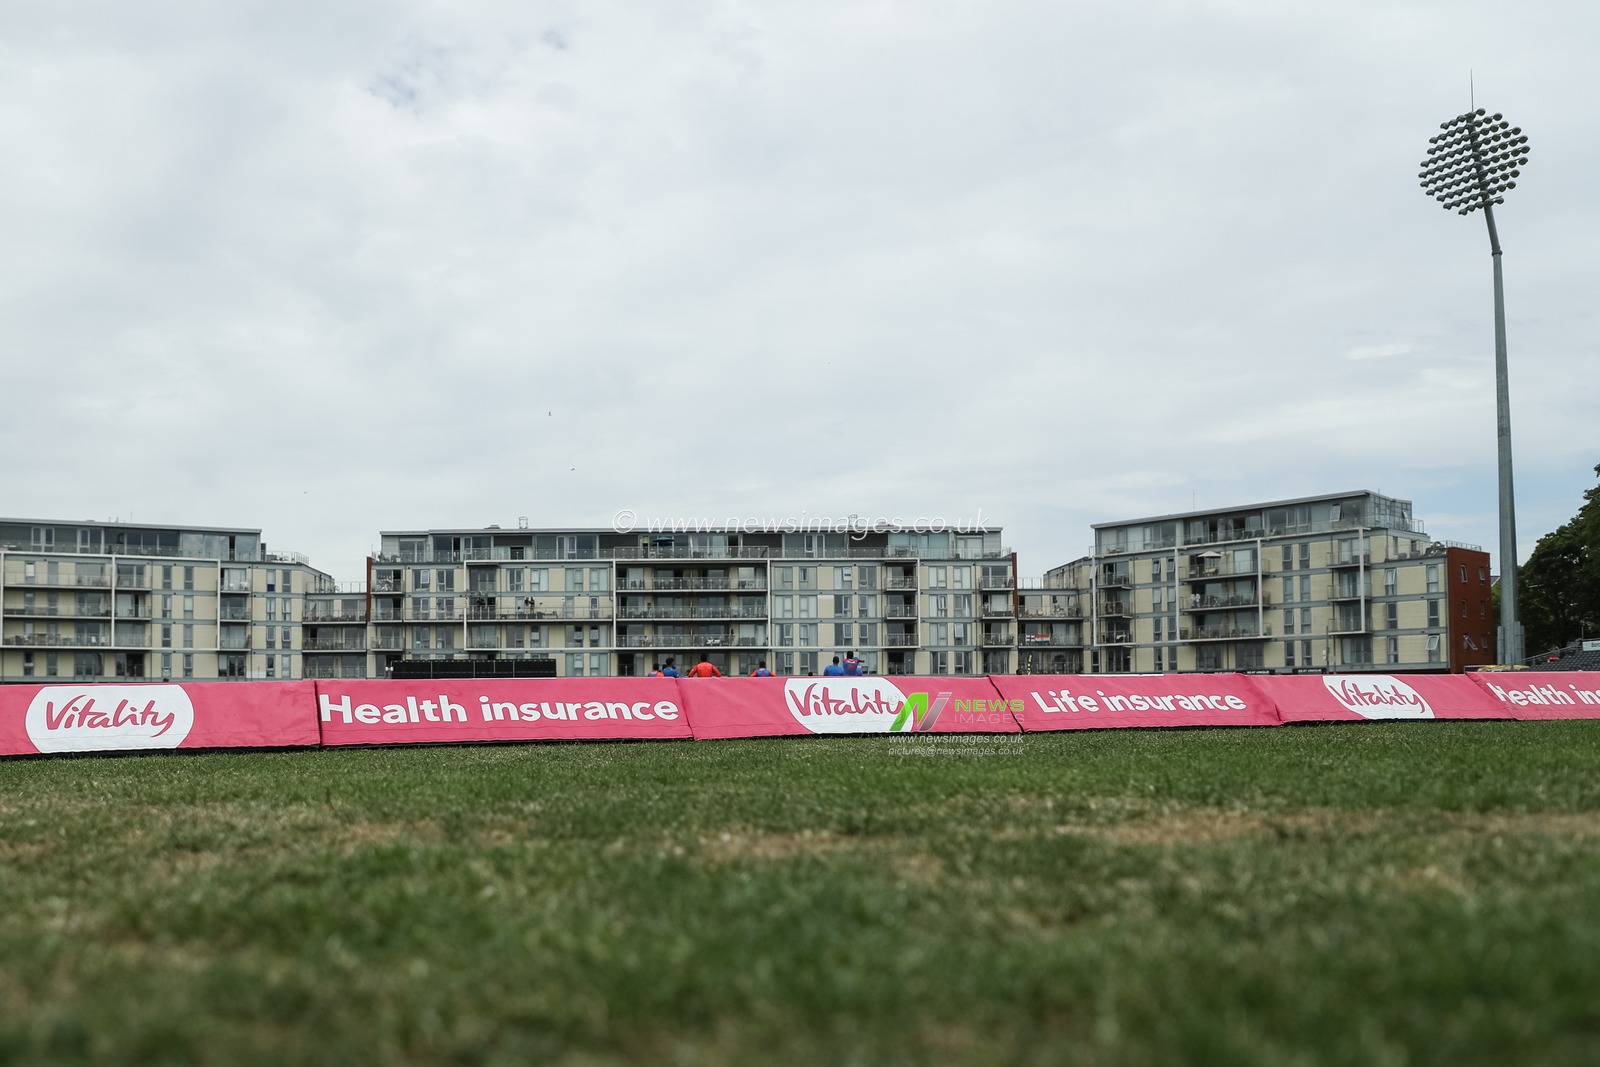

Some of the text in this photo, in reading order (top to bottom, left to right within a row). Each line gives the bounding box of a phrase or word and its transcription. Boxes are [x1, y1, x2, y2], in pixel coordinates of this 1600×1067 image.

[319, 694, 679, 724] Health insurance
[789, 683, 907, 724] Vitality
[1030, 689, 1247, 713] Life insurance
[1328, 680, 1426, 714] Vitality
[1486, 682, 1576, 706] Health
[46, 694, 175, 737] Vitality
